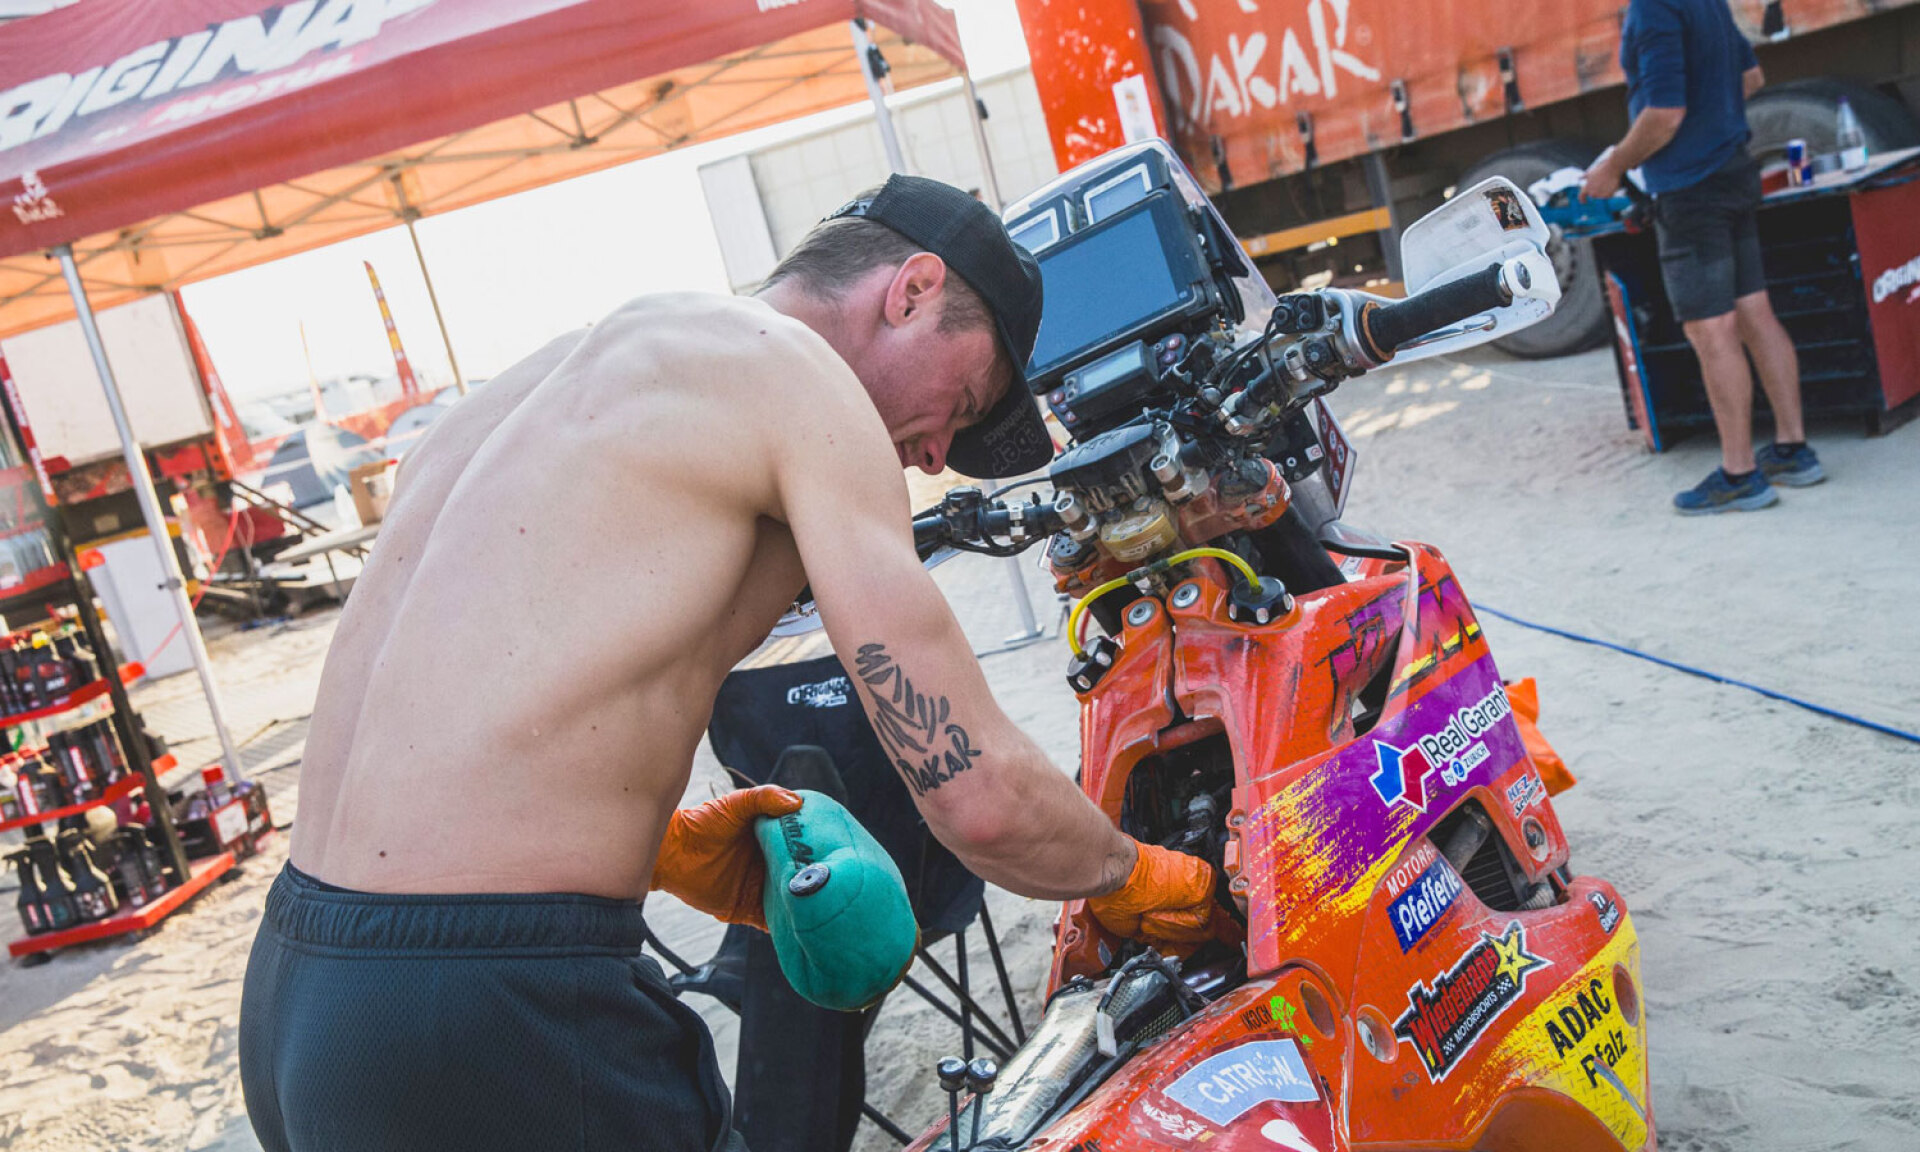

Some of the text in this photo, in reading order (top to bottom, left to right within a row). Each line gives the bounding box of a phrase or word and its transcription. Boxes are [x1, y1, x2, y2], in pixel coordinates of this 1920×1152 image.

[1152, 0, 1382, 136] DAKAR
[897, 724, 982, 797] DAKAR
[1422, 718, 1468, 765] Real
[1463, 744, 1487, 769] ZURICH
[1409, 946, 1500, 1067] Wiedemann
[1453, 990, 1499, 1044] MOTORSPORTS
[1545, 978, 1612, 1060] ADAC
[1580, 1030, 1629, 1089] Pfalz
